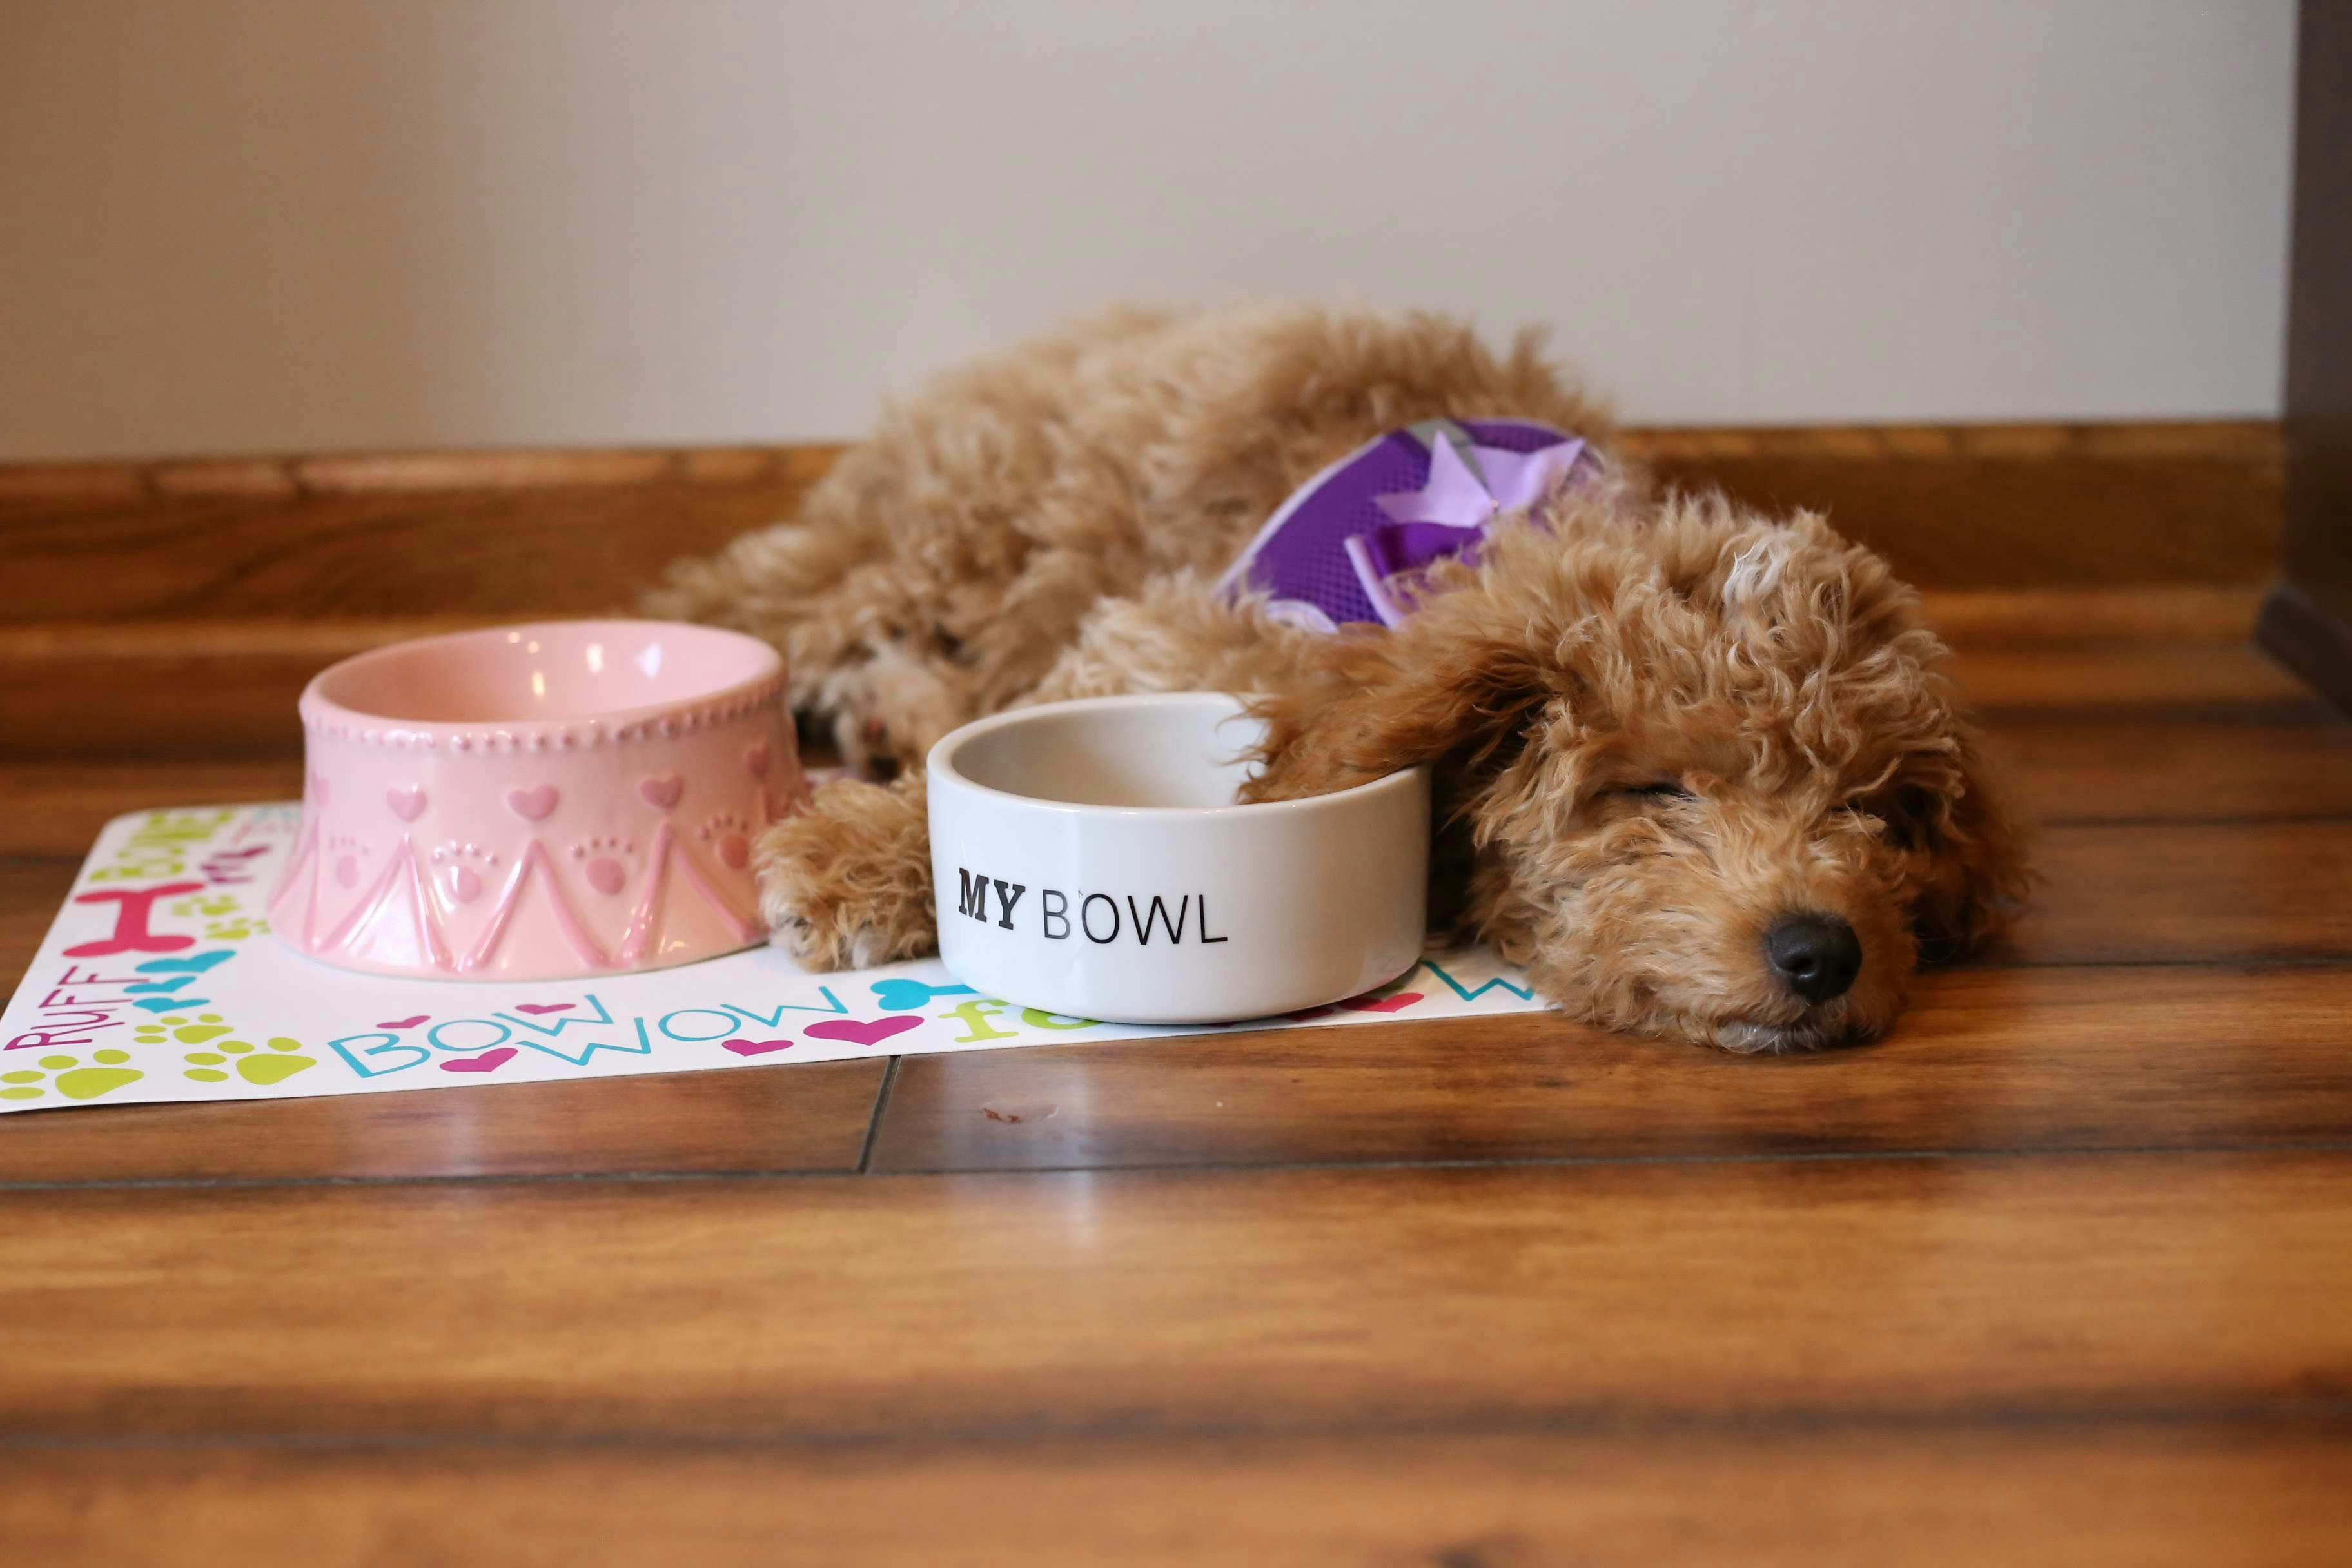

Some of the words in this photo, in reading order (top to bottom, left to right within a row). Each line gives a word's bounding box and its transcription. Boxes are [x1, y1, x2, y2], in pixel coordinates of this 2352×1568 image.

[959, 867, 1026, 930] MY
[1042, 889, 1228, 945] BOWL
[3, 965, 150, 1050] RUFF
